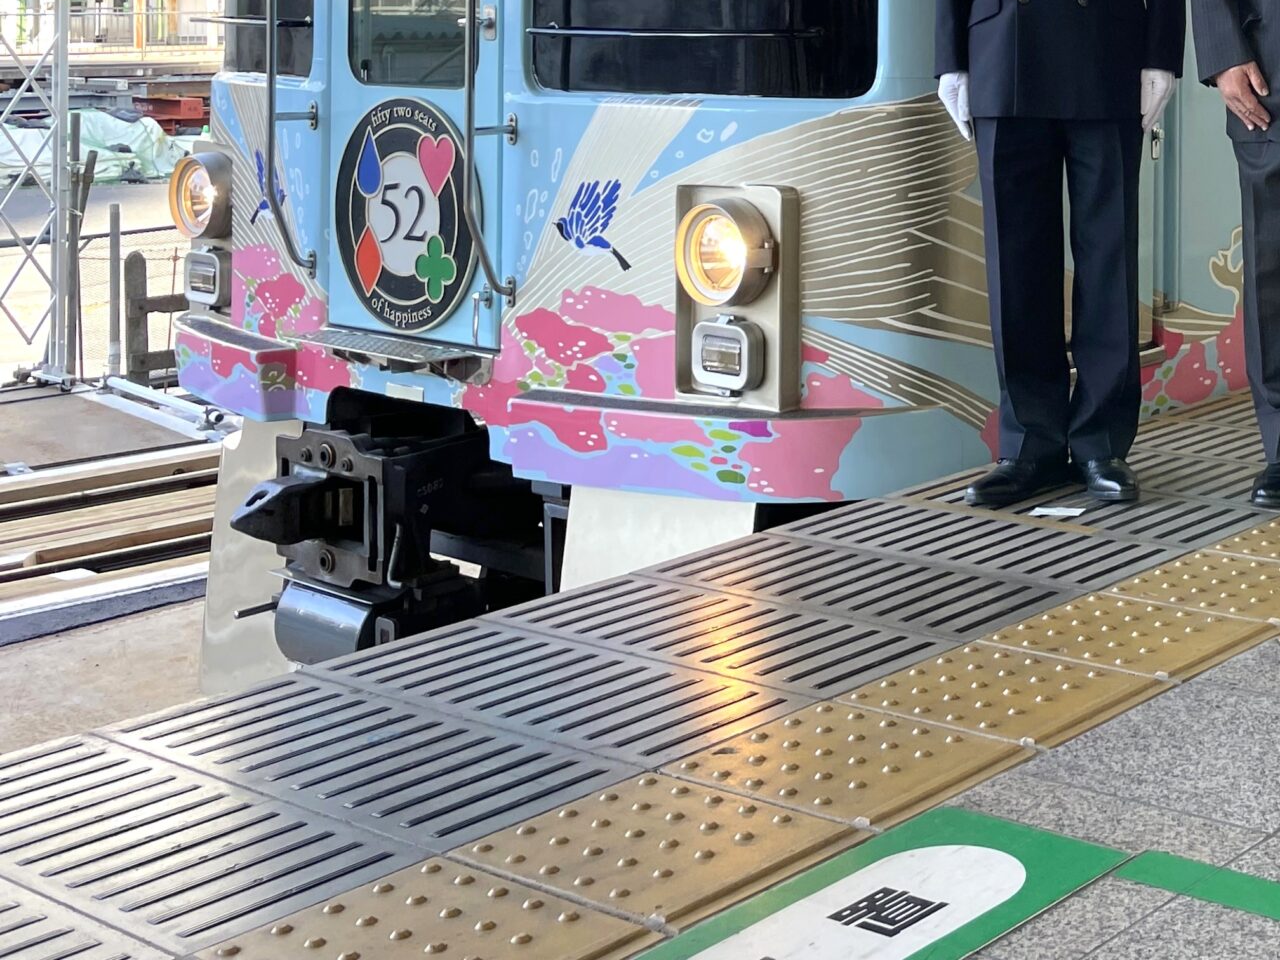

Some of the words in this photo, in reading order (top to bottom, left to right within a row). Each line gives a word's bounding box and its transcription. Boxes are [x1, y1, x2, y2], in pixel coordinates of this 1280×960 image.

[370, 106, 392, 128] fifty
[393, 106, 412, 119] two
[413, 109, 438, 131] seats
[380, 182, 428, 244] 52
[371, 297, 384, 314] of
[384, 304, 432, 327] happiness
[826, 886, 950, 938] 置
